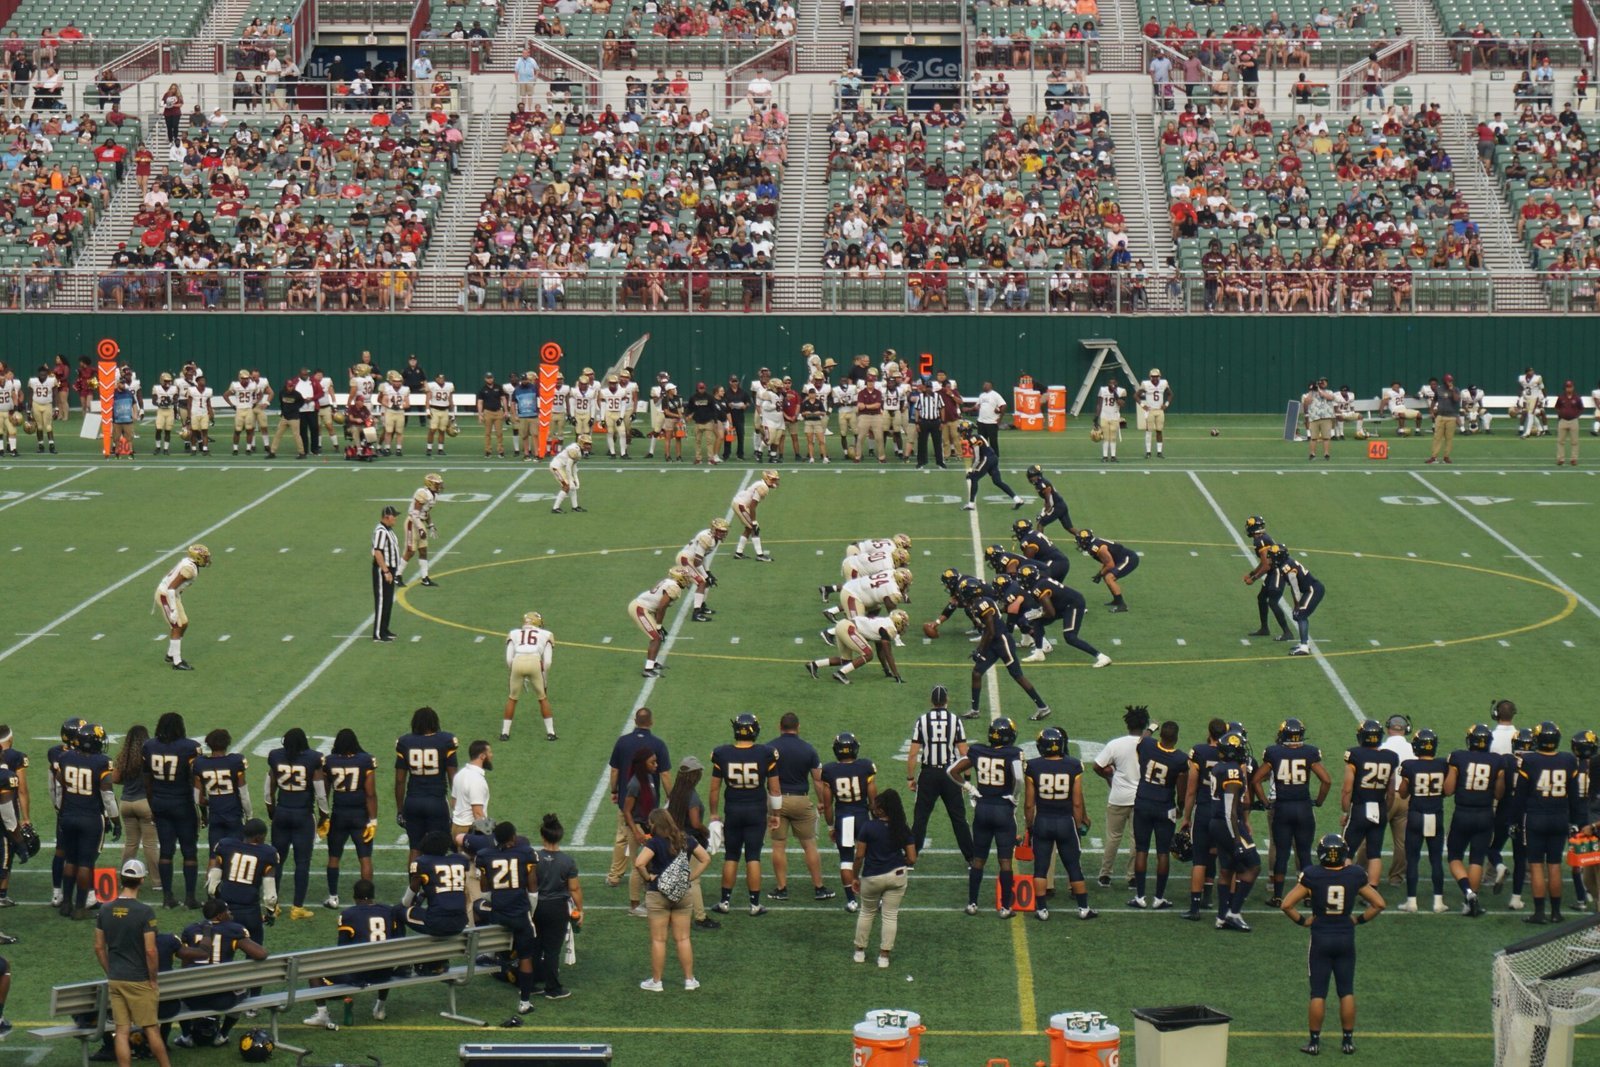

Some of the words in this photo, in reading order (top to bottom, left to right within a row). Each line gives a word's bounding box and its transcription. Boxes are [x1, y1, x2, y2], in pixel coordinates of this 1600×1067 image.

[920, 354, 932, 375] 2
[36, 387, 48, 397] 63
[239, 392, 250, 402] 25
[608, 398, 619, 409] 36
[1153, 391, 1159, 401] 6
[1371, 444, 1386, 456] 40
[519, 630, 539, 646] 16
[931, 720, 948, 742] H
[151, 755, 179, 781] 97
[408, 748, 439, 775] 99
[977, 757, 1005, 786] 86
[1145, 760, 1168, 785] 13
[1277, 759, 1307, 785] 46
[65, 766, 92, 795] 90
[202, 769, 234, 795] 25
[277, 765, 307, 791] 23
[331, 767, 360, 792] 27
[727, 762, 759, 788] 56
[1039, 774, 1070, 800] 89
[1361, 762, 1391, 789] 29
[1414, 772, 1444, 797] 83
[1465, 763, 1491, 791] 18
[1536, 769, 1567, 797] 48
[835, 776, 861, 802] 81
[228, 852, 259, 884] 10
[435, 864, 466, 894] 38
[492, 858, 519, 889] 21
[1325, 885, 1345, 915] 9
[369, 917, 387, 942] 8
[854, 1048, 863, 1066] G
